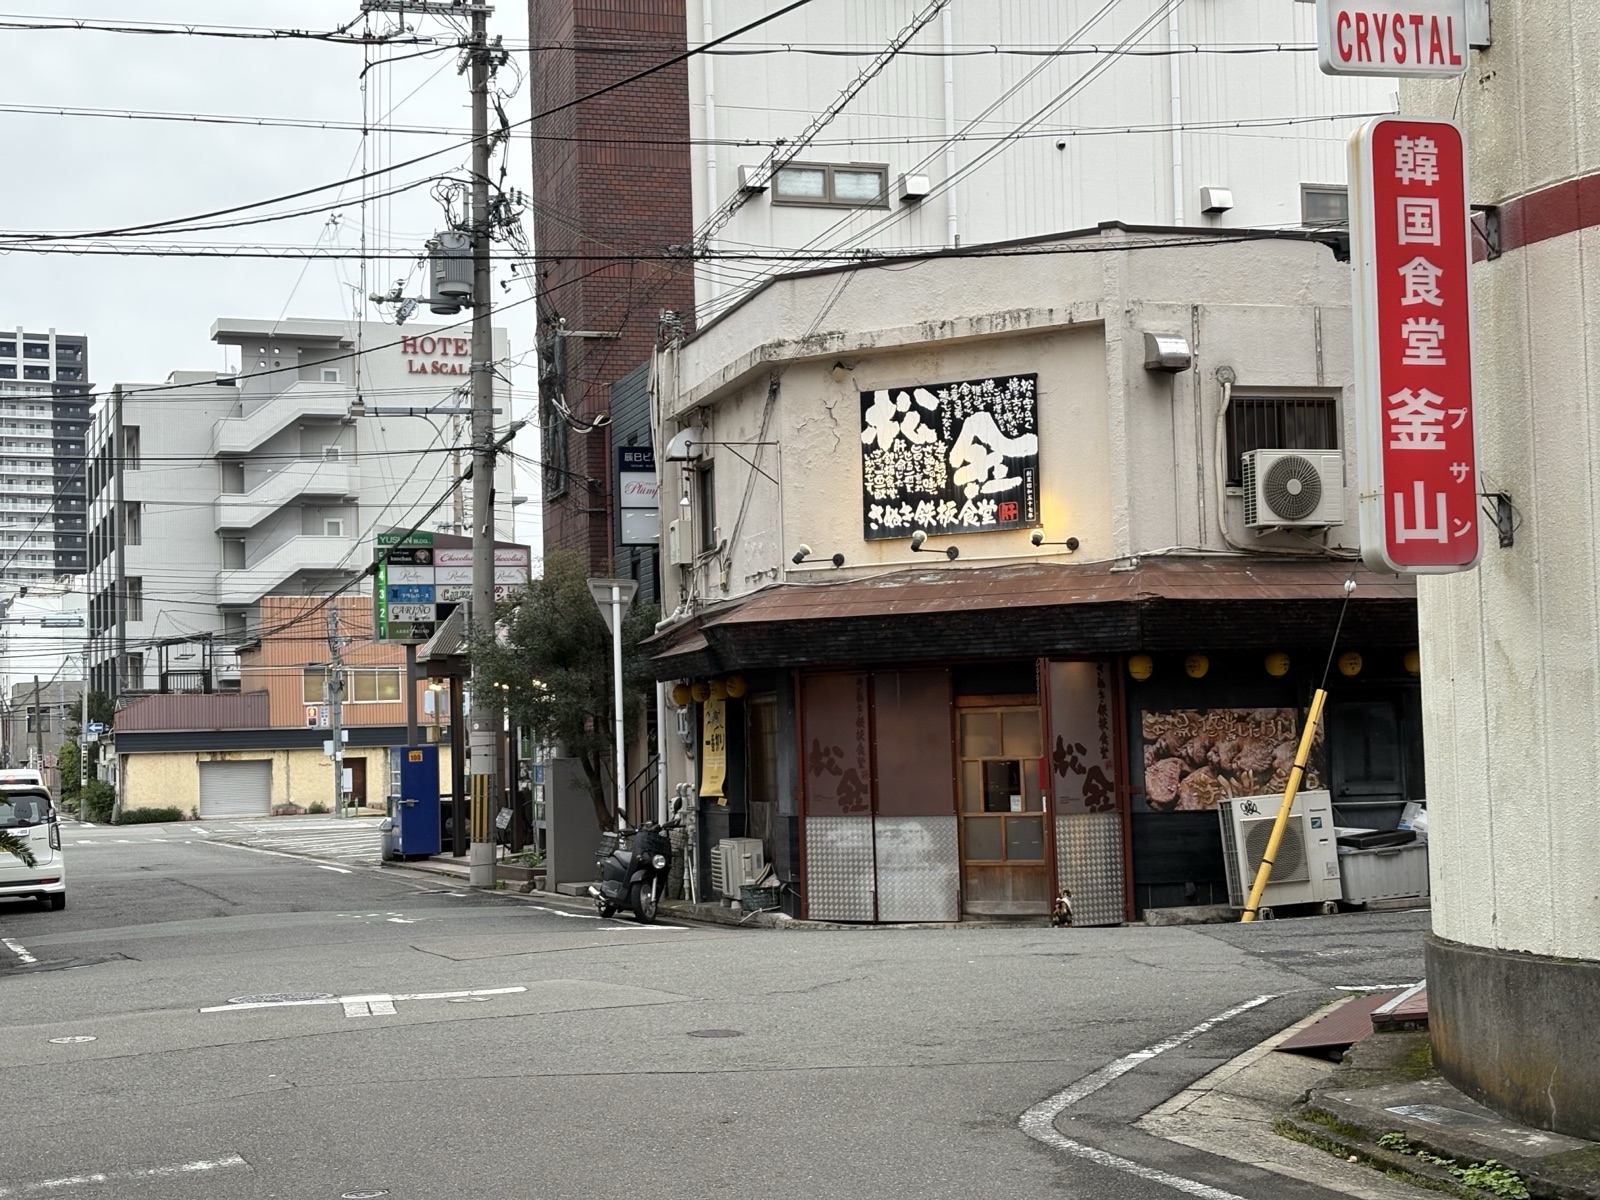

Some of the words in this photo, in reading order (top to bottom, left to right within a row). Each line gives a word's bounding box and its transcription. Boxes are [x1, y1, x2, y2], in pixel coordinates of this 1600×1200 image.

[1337, 11, 1461, 65] CRYSTAL
[401, 335, 472, 356] HOTE
[408, 360, 428, 374] LA
[1447, 407, 1472, 538] プサン
[868, 499, 998, 530] さぬき鉄板食堂
[380, 536, 412, 544] YUSN
[440, 553, 473, 562] Chocola
[378, 571, 384, 581] 4
[379, 589, 384, 599] 3
[379, 608, 385, 618] 2
[380, 626, 384, 636] 1
